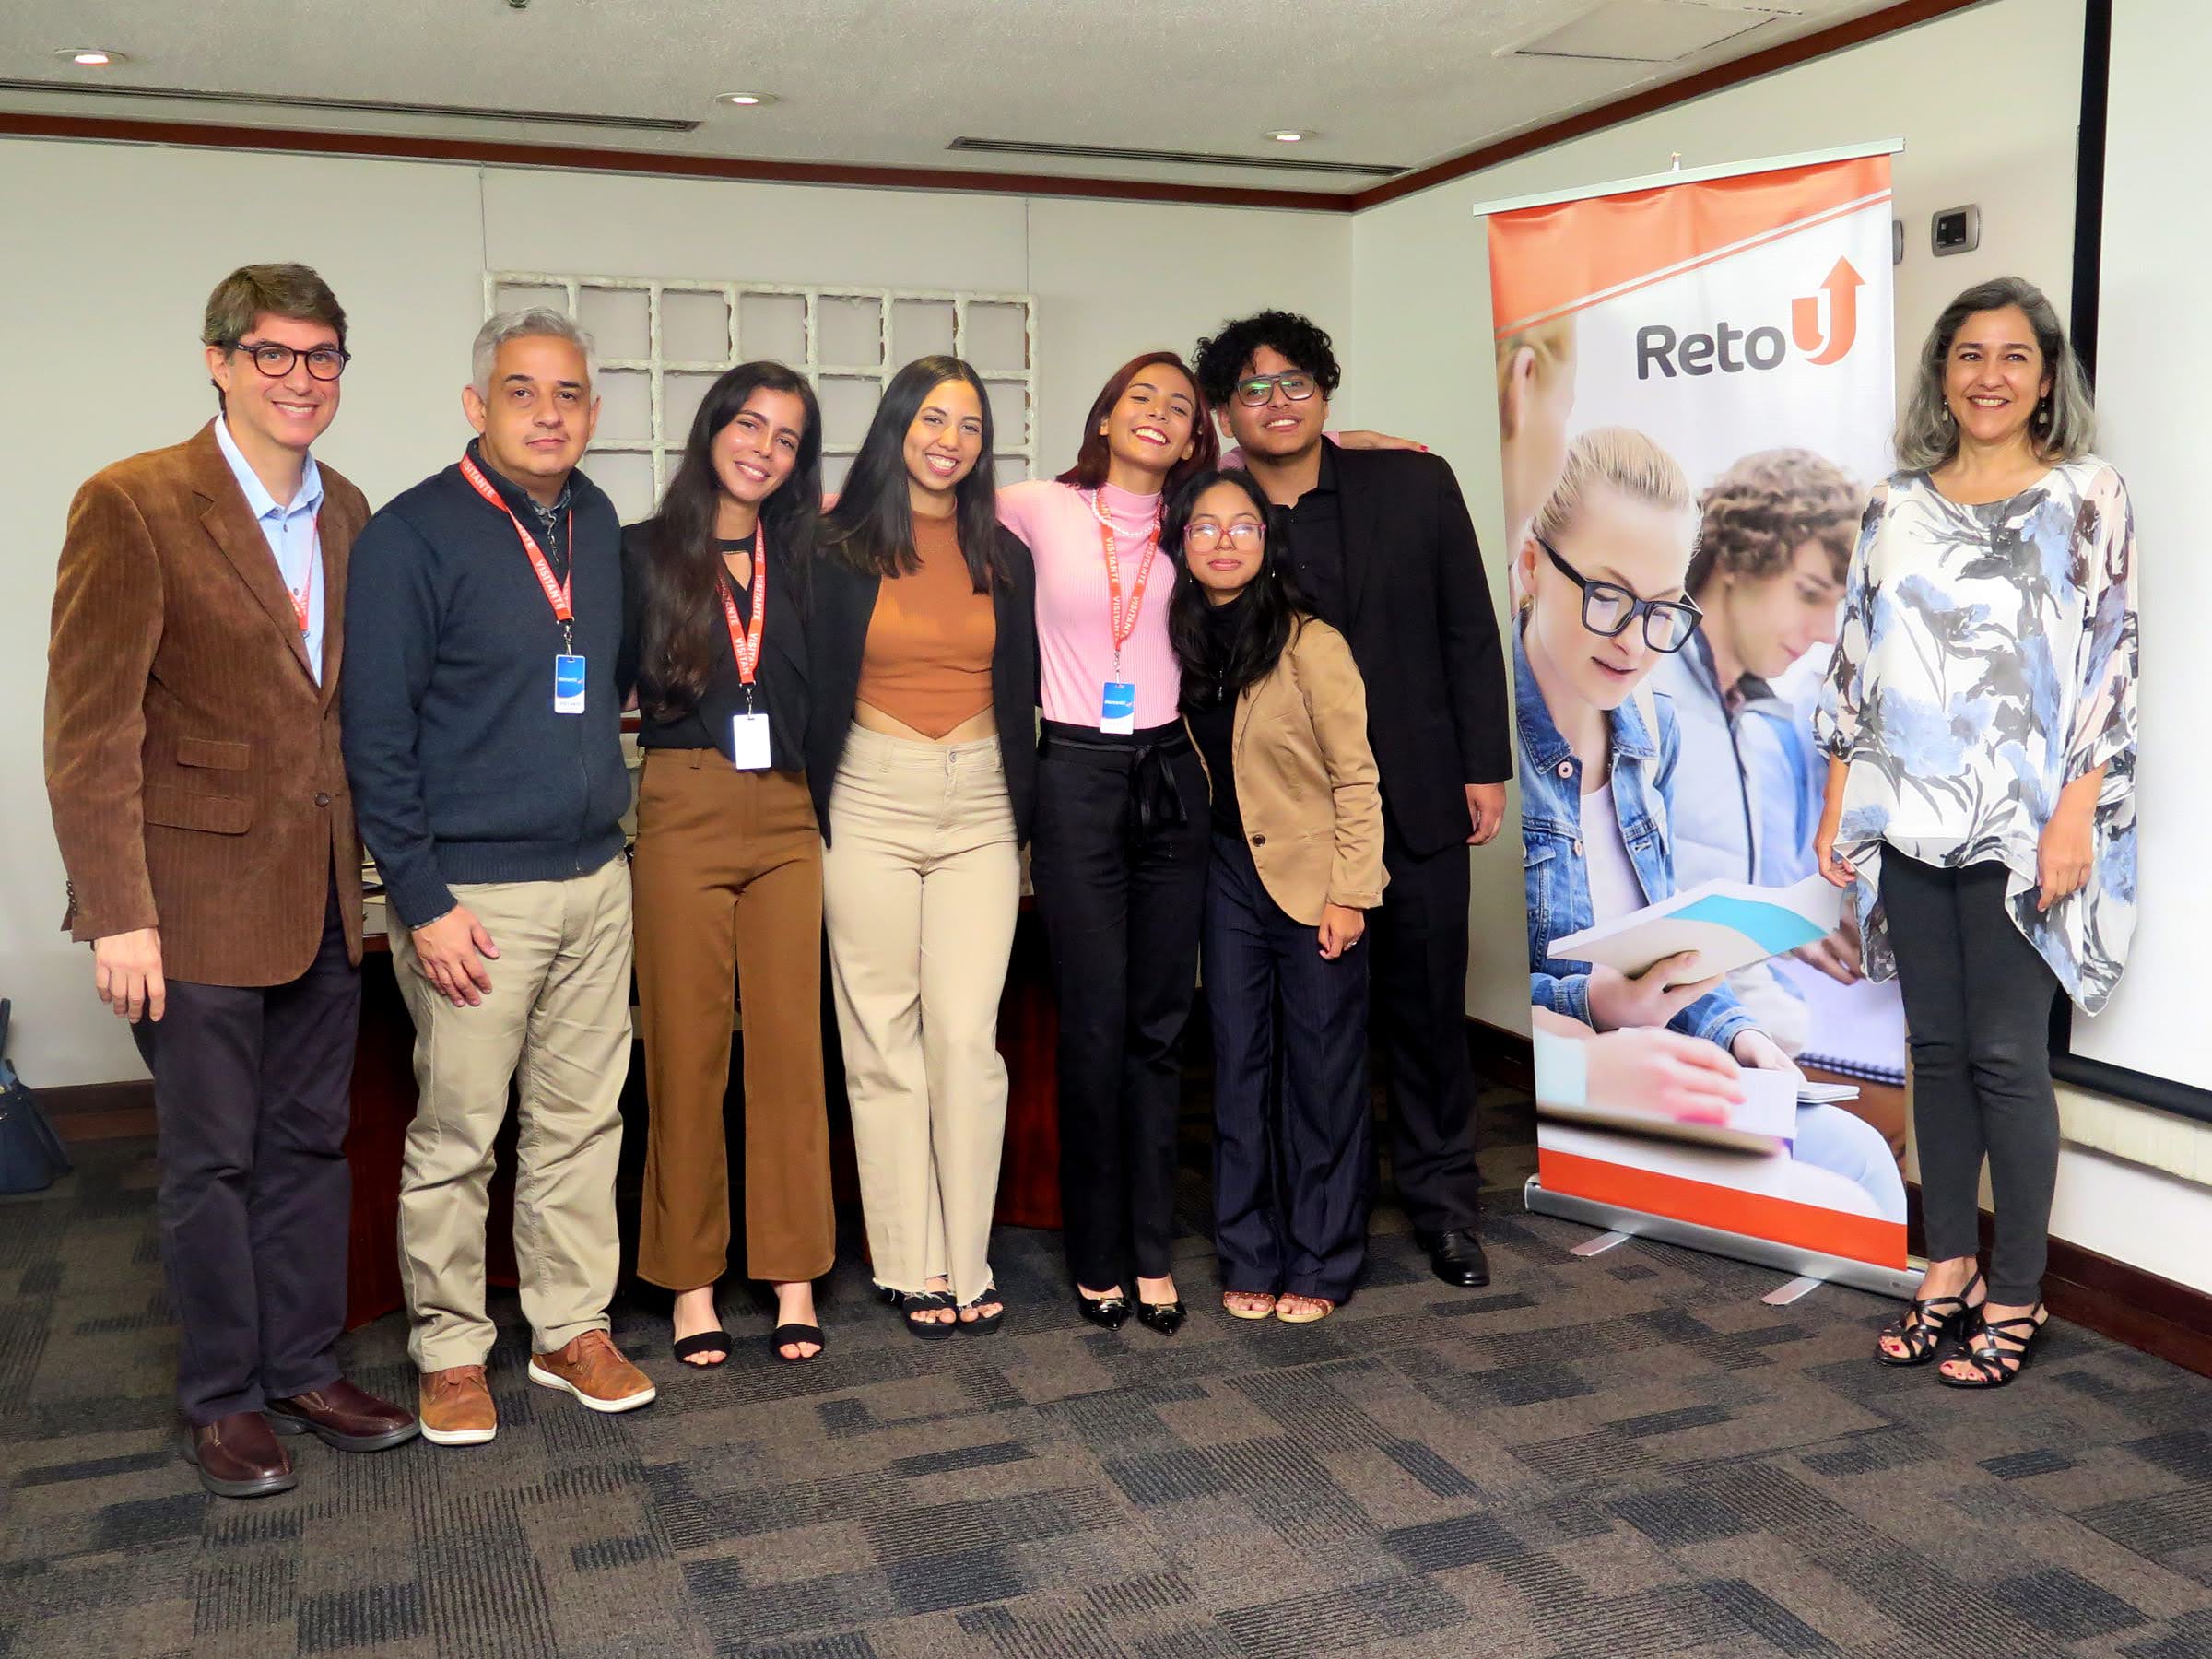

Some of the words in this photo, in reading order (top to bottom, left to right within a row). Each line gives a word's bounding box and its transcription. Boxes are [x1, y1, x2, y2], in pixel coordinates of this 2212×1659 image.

[1105, 536, 1120, 583] VISITANTE
[1137, 541, 1156, 585] VISITANTE
[535, 559, 567, 609] VISITANTE
[752, 574, 764, 621] VISITANTE
[1112, 596, 1122, 639] VISITANT
[735, 637, 750, 674] VISITAN
